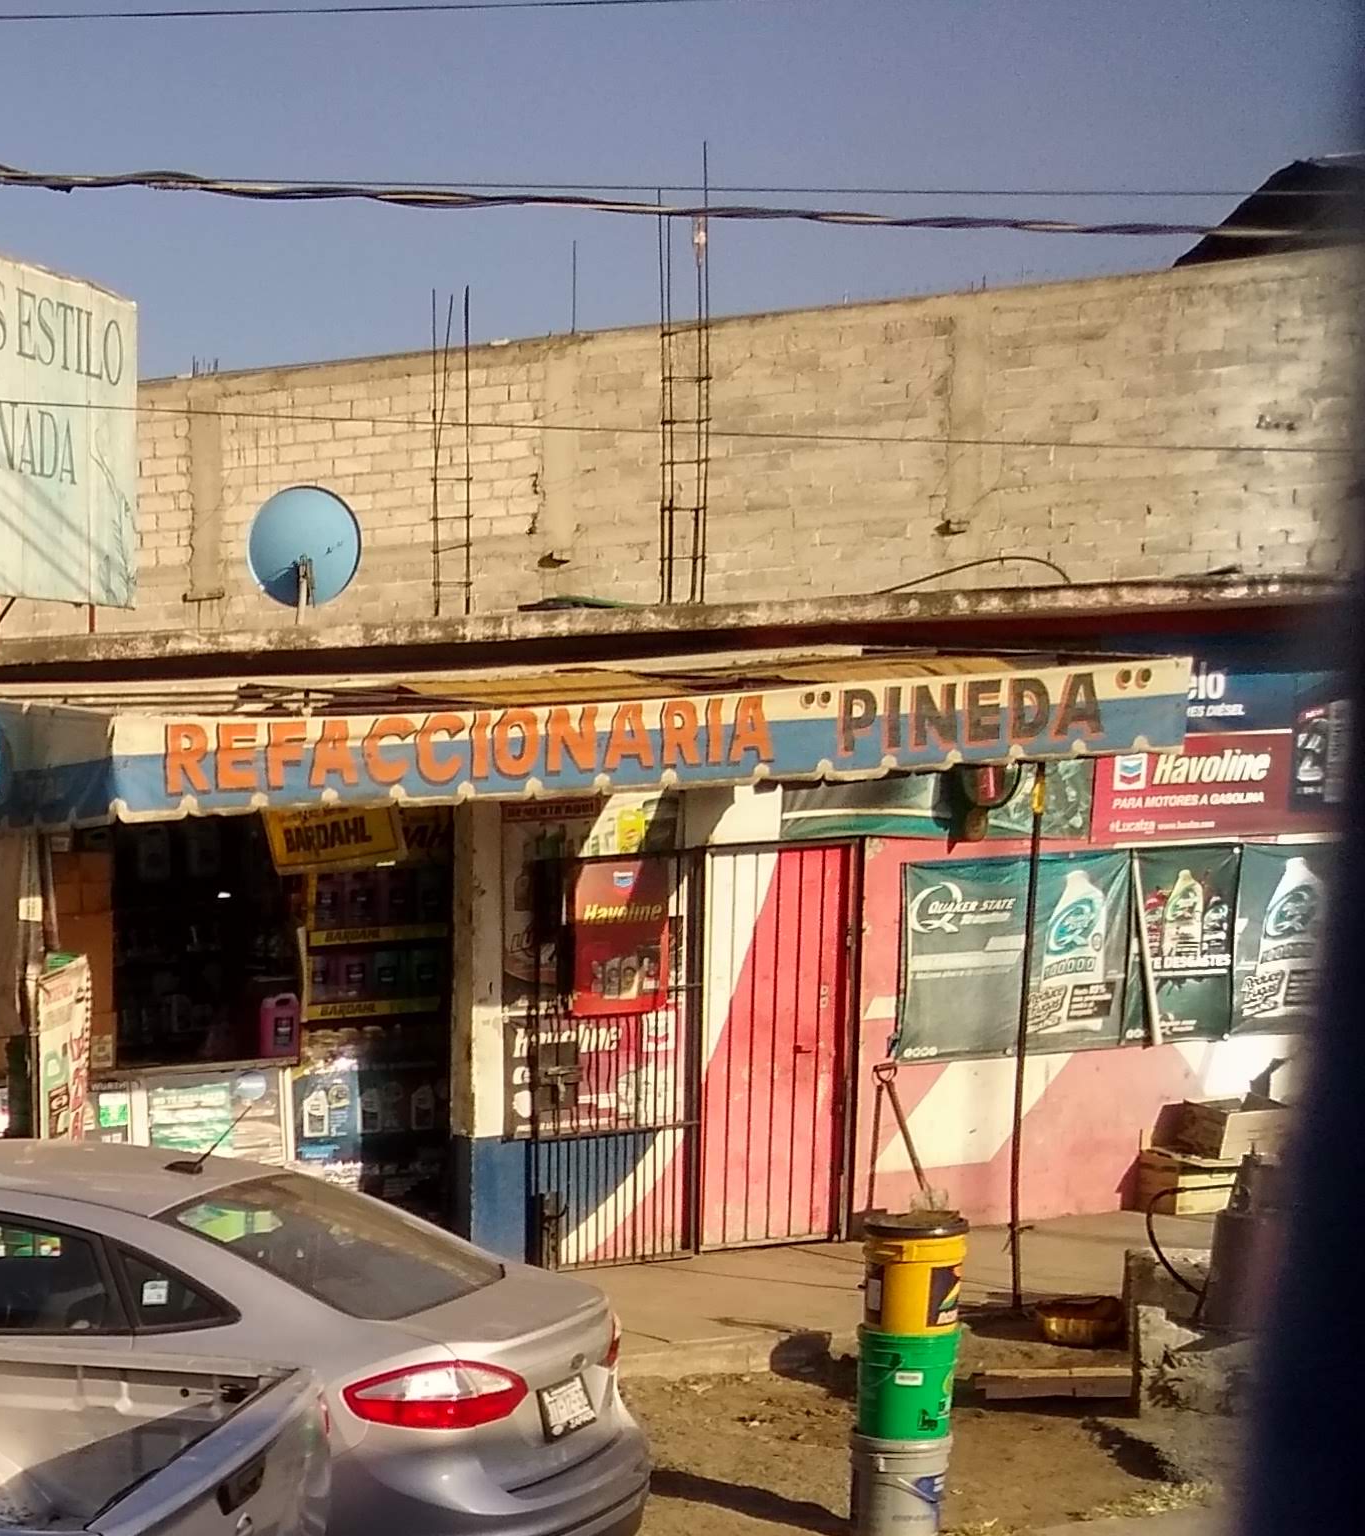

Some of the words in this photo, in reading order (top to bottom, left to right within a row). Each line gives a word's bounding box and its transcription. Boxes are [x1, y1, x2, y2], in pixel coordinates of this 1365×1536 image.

[16, 284, 124, 386] ESTILO
[164, 694, 774, 797] REFACCIONARIA
[1151, 748, 1272, 785] Havoline
[1112, 796, 1144, 810] PARA
[282, 815, 373, 853] BARDAHL
[583, 902, 663, 922] Havoline
[928, 900, 978, 915] QUAKER
[980, 897, 1016, 911] STATE
